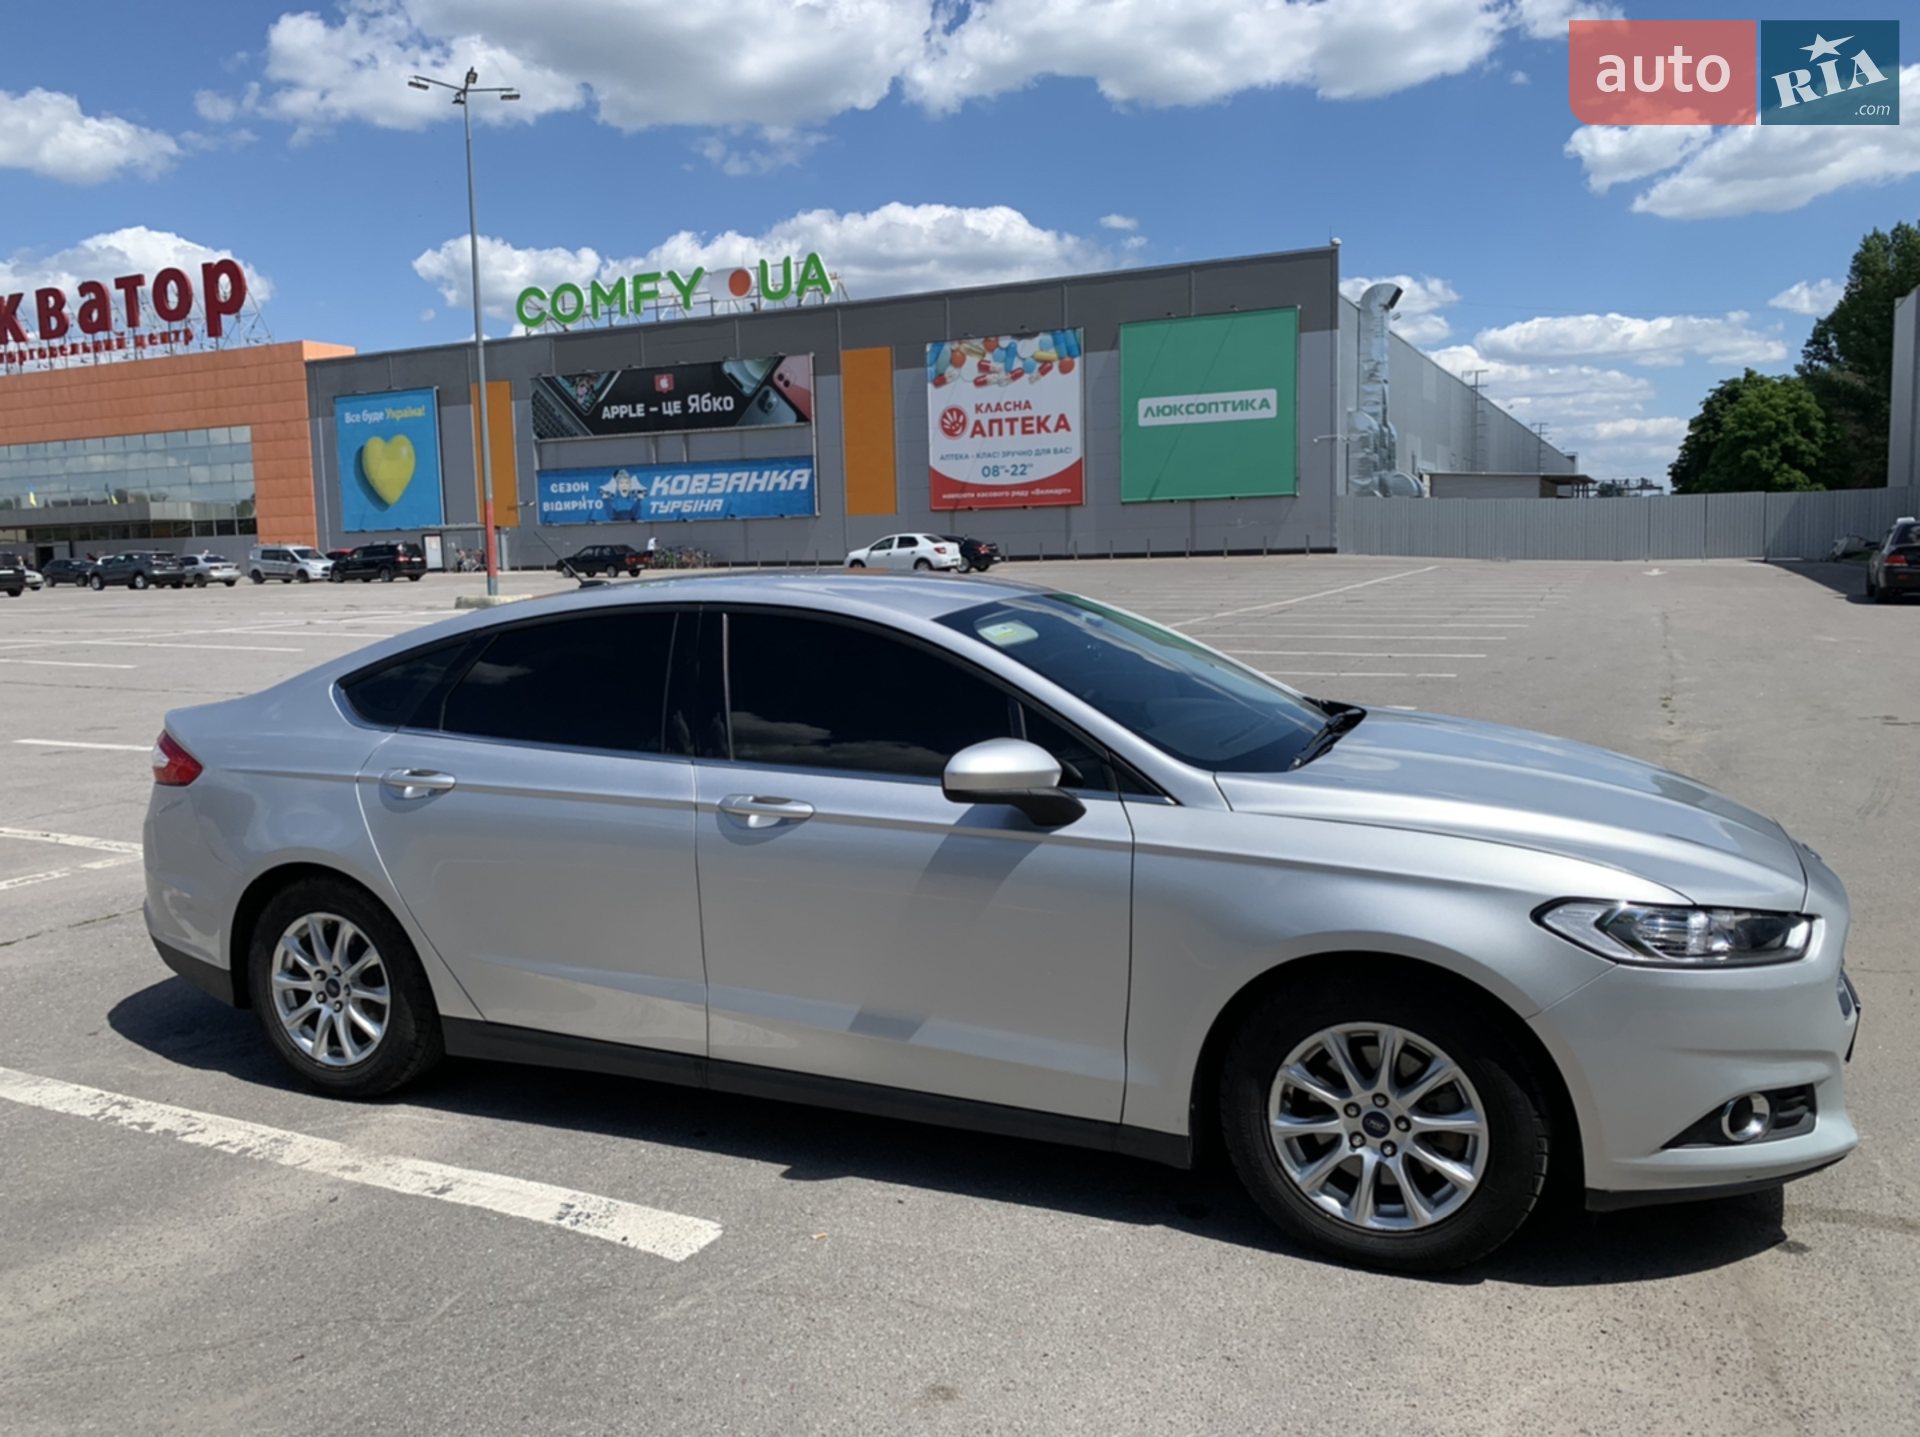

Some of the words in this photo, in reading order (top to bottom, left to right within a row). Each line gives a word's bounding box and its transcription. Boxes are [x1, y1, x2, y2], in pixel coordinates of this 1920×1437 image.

[516, 266, 705, 328] COMFY
[759, 252, 833, 301] UA
[602, 404, 645, 420] APPLE
[662, 401, 682, 415] ЦЕ
[974, 400, 1032, 414] КЛАСНА
[344, 411, 361, 424] Все
[361, 409, 384, 424] буде
[970, 413, 1071, 438] АПТЕКА
[939, 453, 970, 461] АПТЕКА
[976, 452, 1000, 460] КЛАС!
[1001, 449, 1033, 459] ЗРУЧНО
[1034, 448, 1051, 457] ДЛЯ
[1053, 447, 1073, 455] ВАС!
[550, 481, 589, 493] СЕЗОН
[650, 468, 812, 497] КОВЗАНКА
[650, 498, 724, 515] ТУРБІНА
